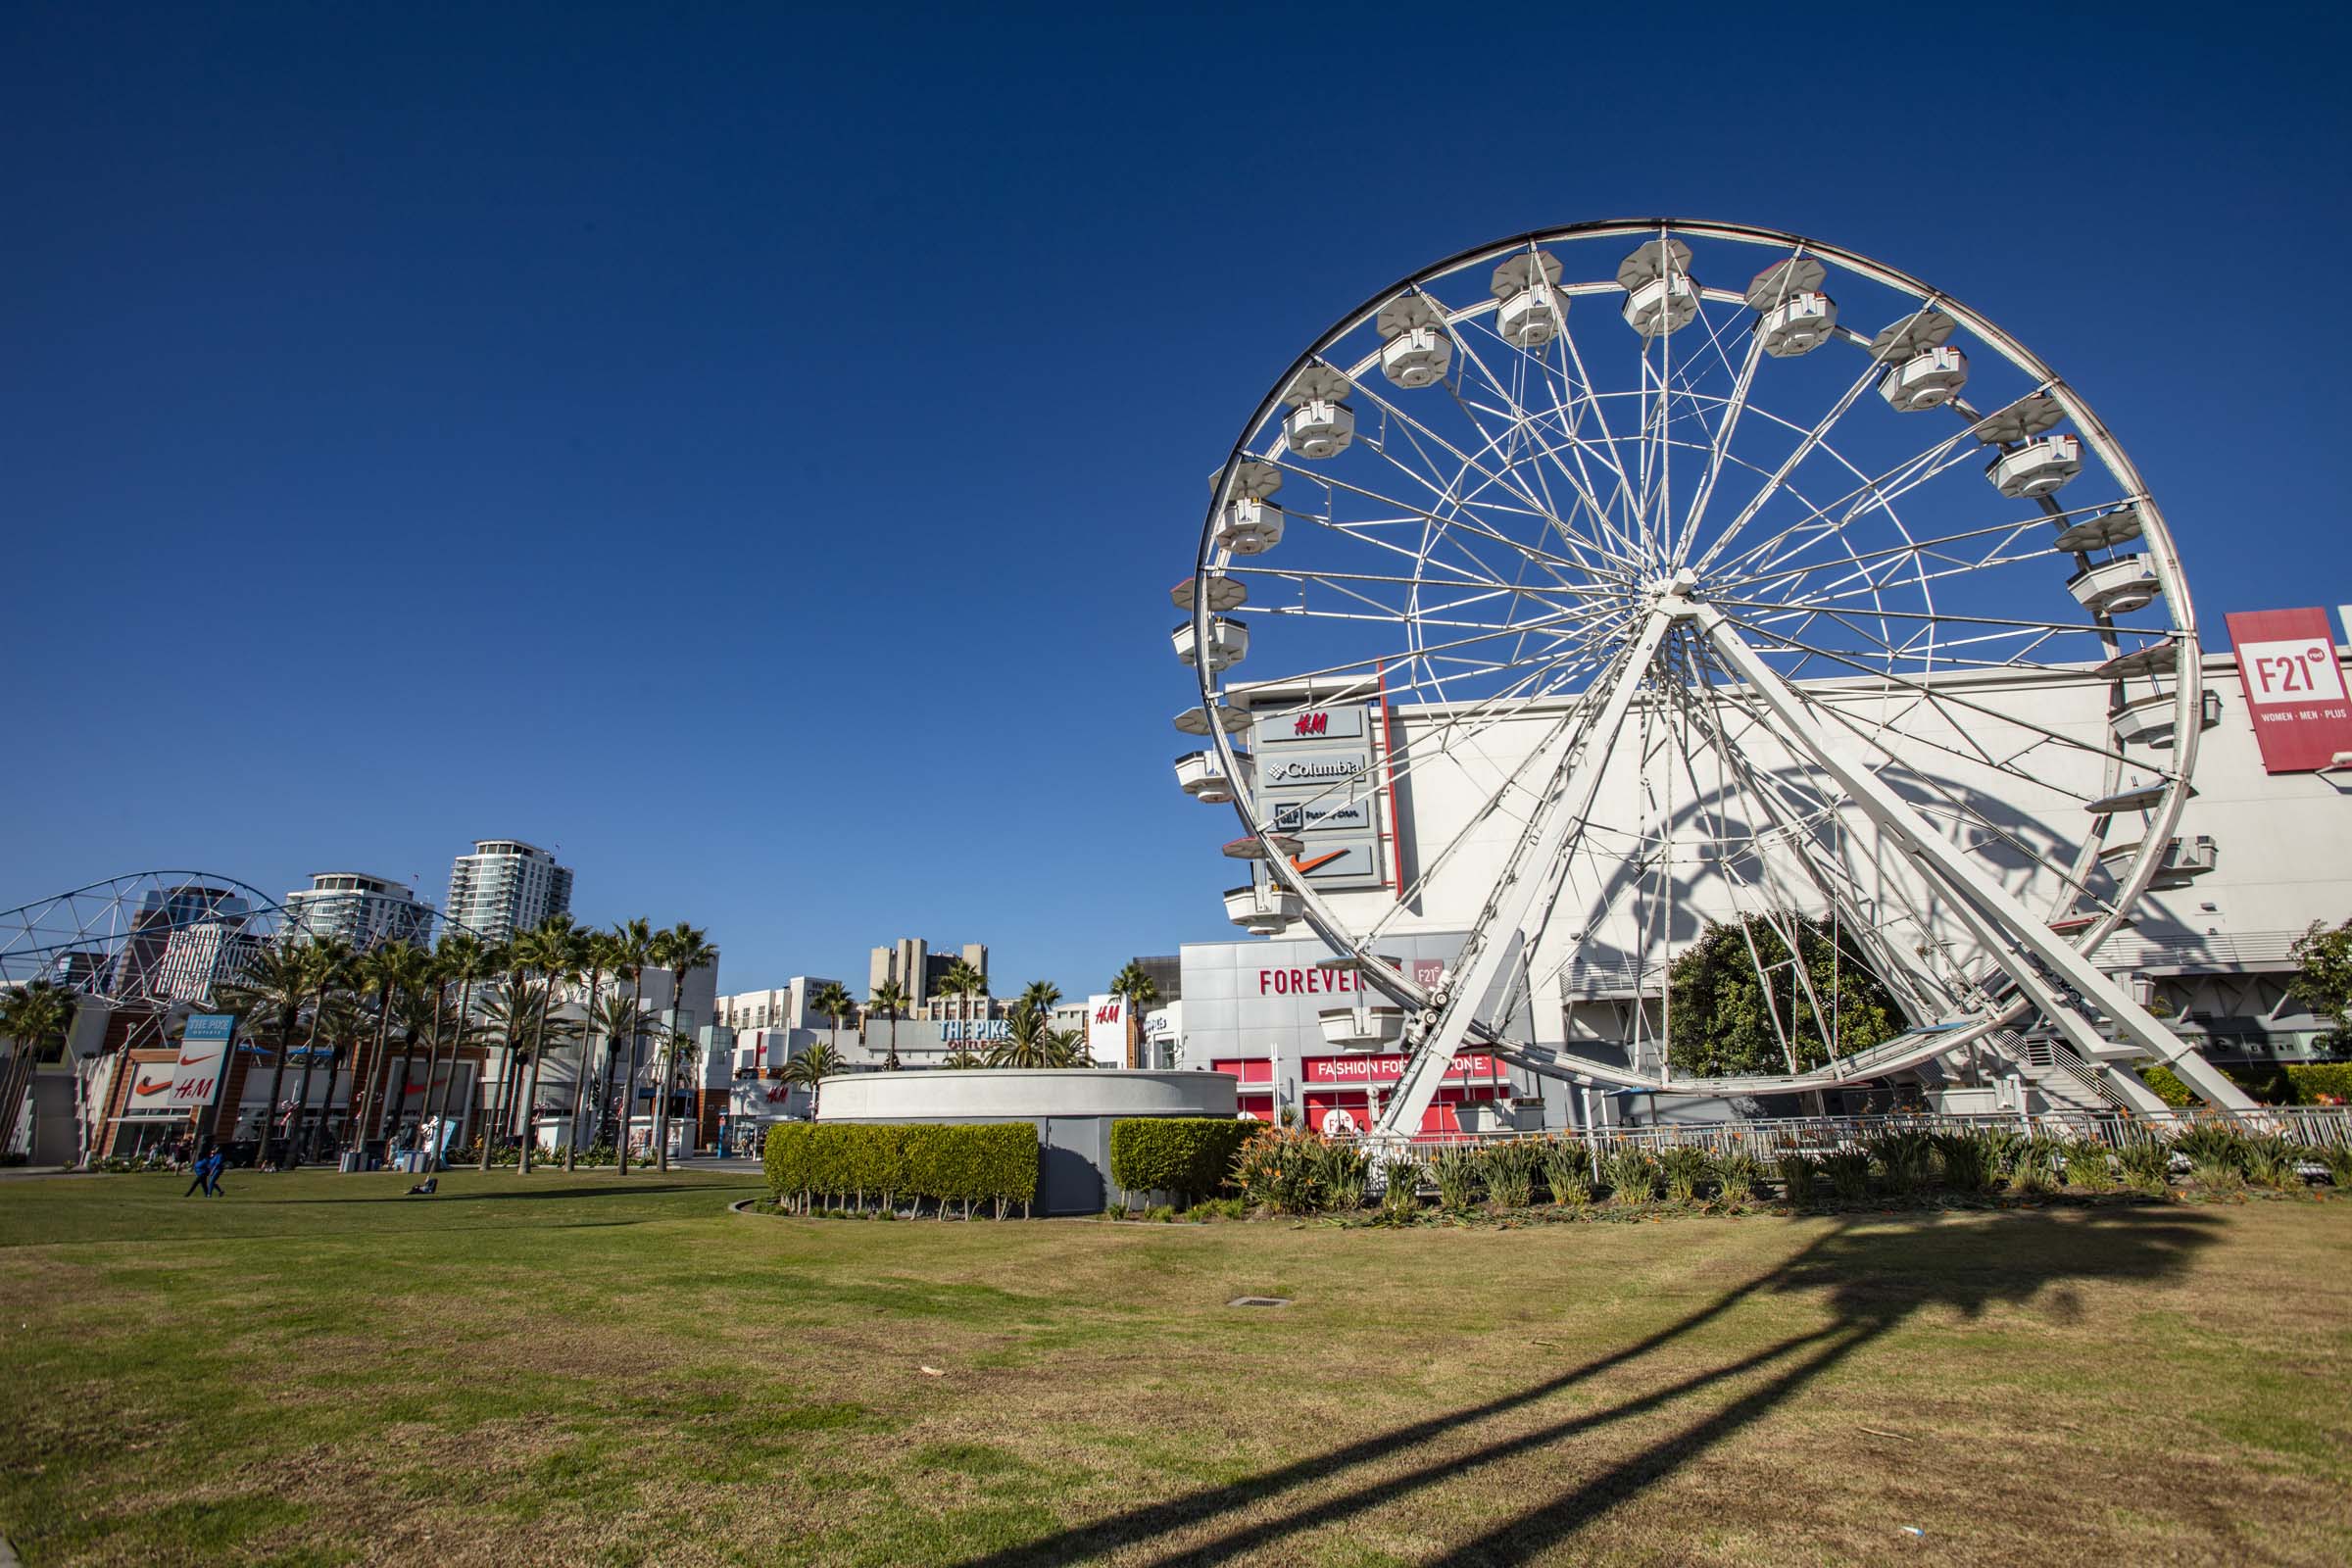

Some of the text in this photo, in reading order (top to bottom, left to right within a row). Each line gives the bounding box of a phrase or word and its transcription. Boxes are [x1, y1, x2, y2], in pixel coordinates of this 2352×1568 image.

[2255, 656, 2314, 693] F21
[1295, 712, 1328, 736] H&M
[2261, 709, 2347, 722] WOMEN MEN PLUS
[1286, 760, 1361, 778] Columbia
[1418, 969, 1435, 982] F21
[1095, 1004, 1120, 1024] H&M
[941, 1020, 971, 1041] THE
[1318, 1061, 1378, 1075] FASHION
[173, 1078, 215, 1099] H&M
